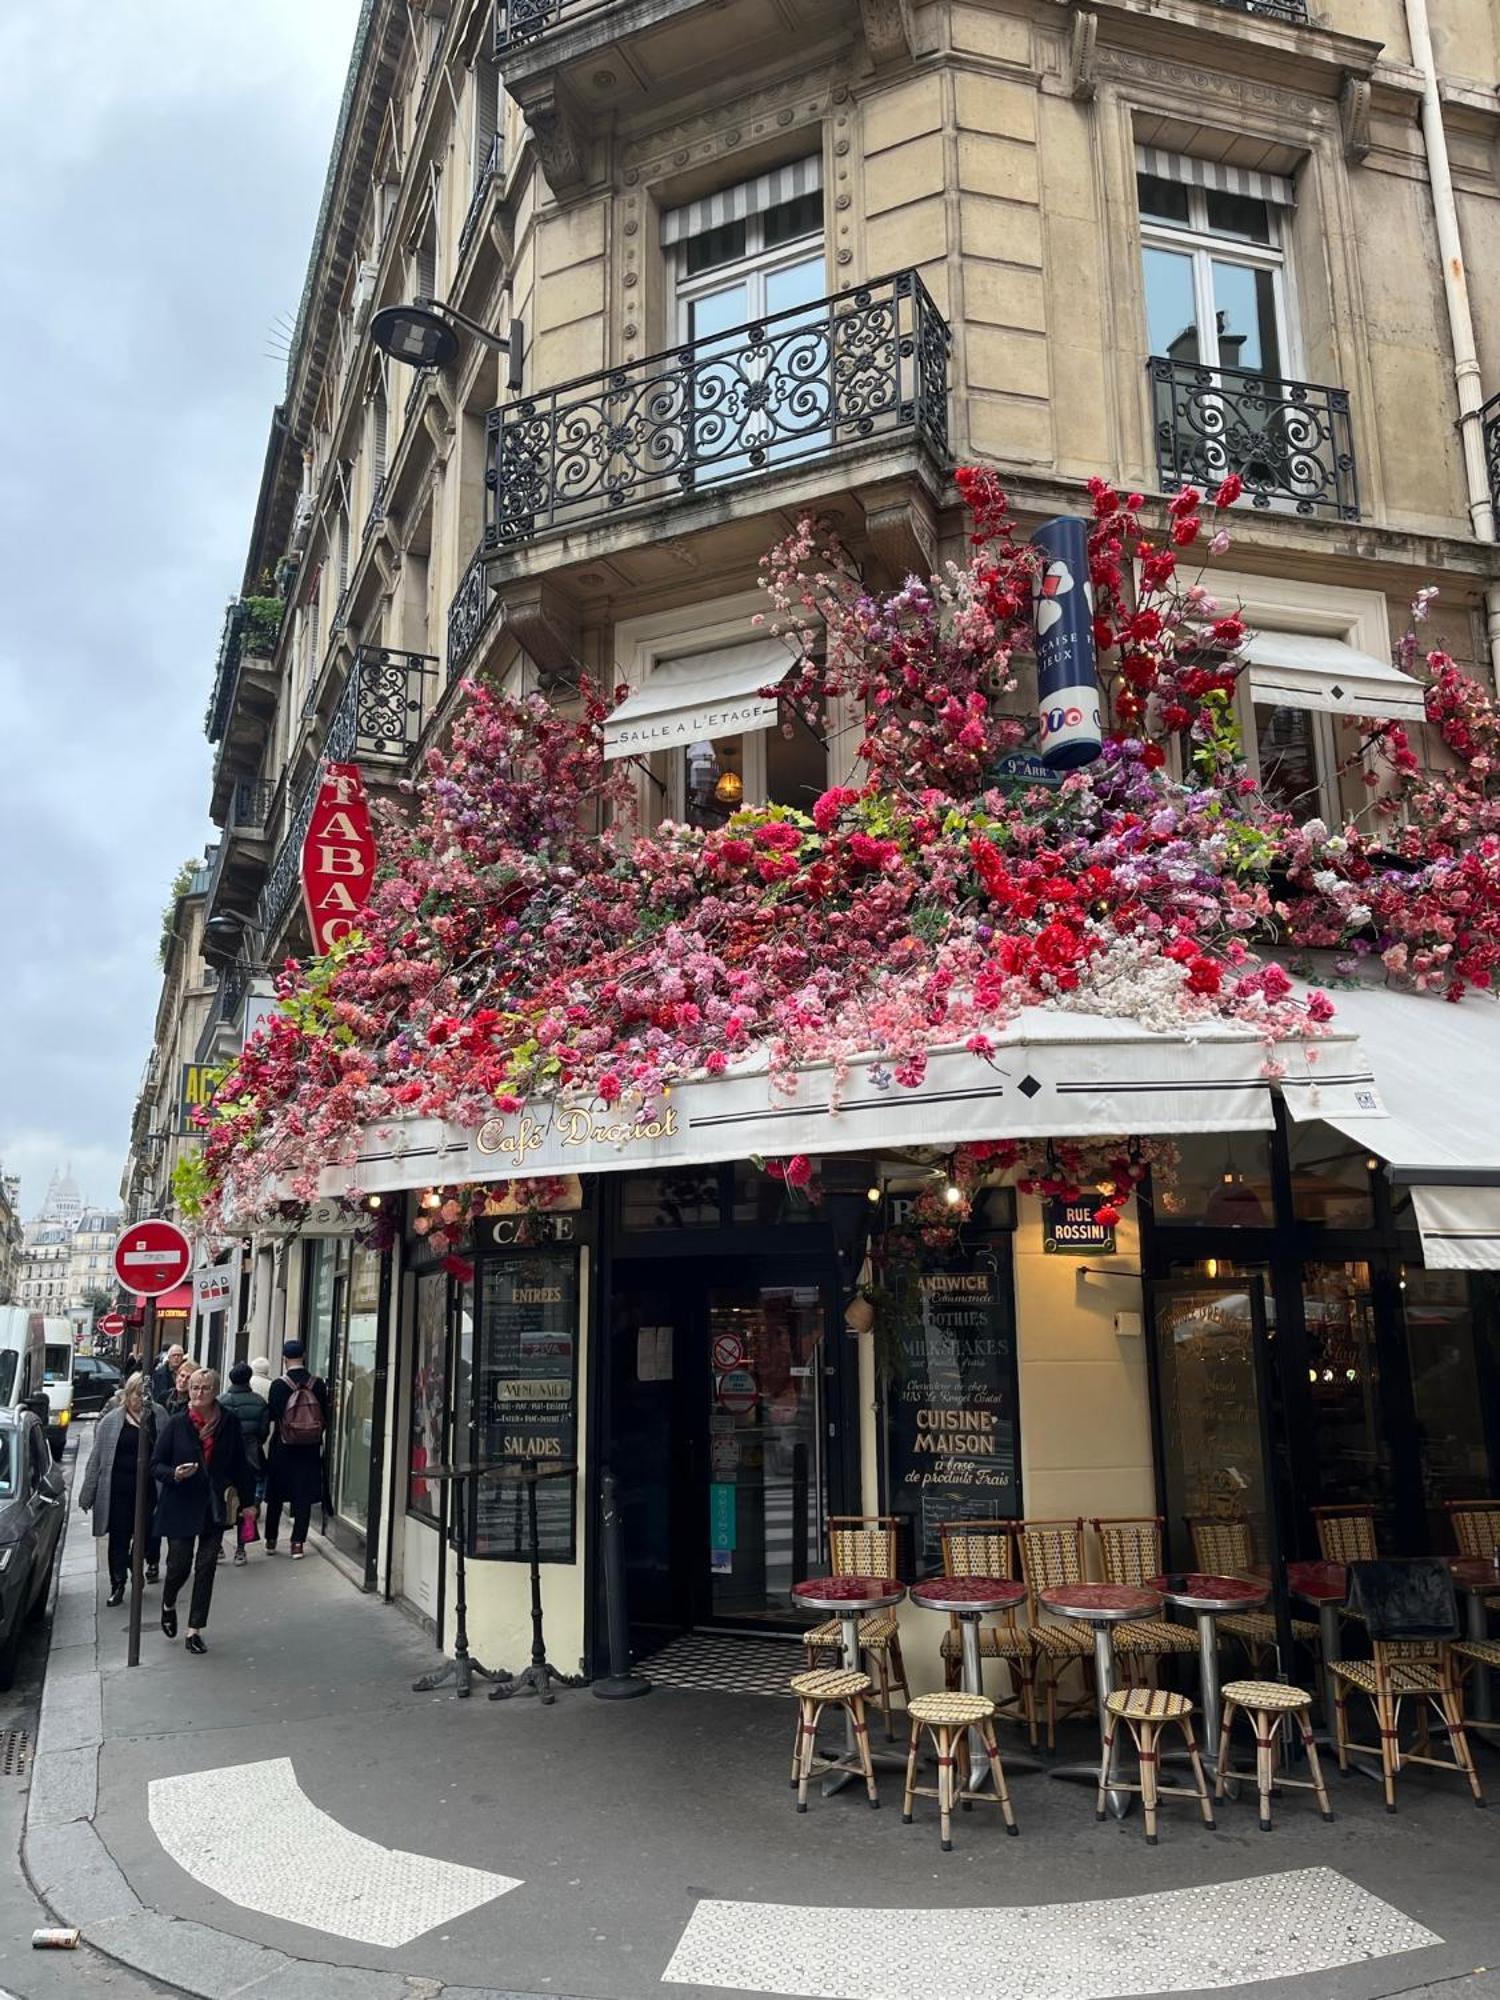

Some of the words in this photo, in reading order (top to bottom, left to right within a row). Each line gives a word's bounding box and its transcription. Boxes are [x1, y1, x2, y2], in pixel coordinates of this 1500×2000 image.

[1043, 649, 1072, 671] JEUX
[619, 726, 671, 743] SALLE
[676, 725, 686, 734] A
[693, 706, 763, 729] L'ETAGE
[316, 775, 366, 947] TABAC
[476, 1117, 545, 1167] Café
[557, 1106, 679, 1148] Drouot
[1066, 1207, 1091, 1222] RUE
[492, 1217, 574, 1244] CFE
[1055, 1225, 1104, 1240] ROSSINI
[917, 1276, 989, 1292] ANDWICH
[916, 1409, 992, 1431] CUISINE
[503, 1436, 561, 1457] SALADES
[913, 1433, 995, 1455] MAISON
[904, 1469, 921, 1483] de
[922, 1470, 973, 1488] produits
[975, 1469, 1010, 1486] Frais
